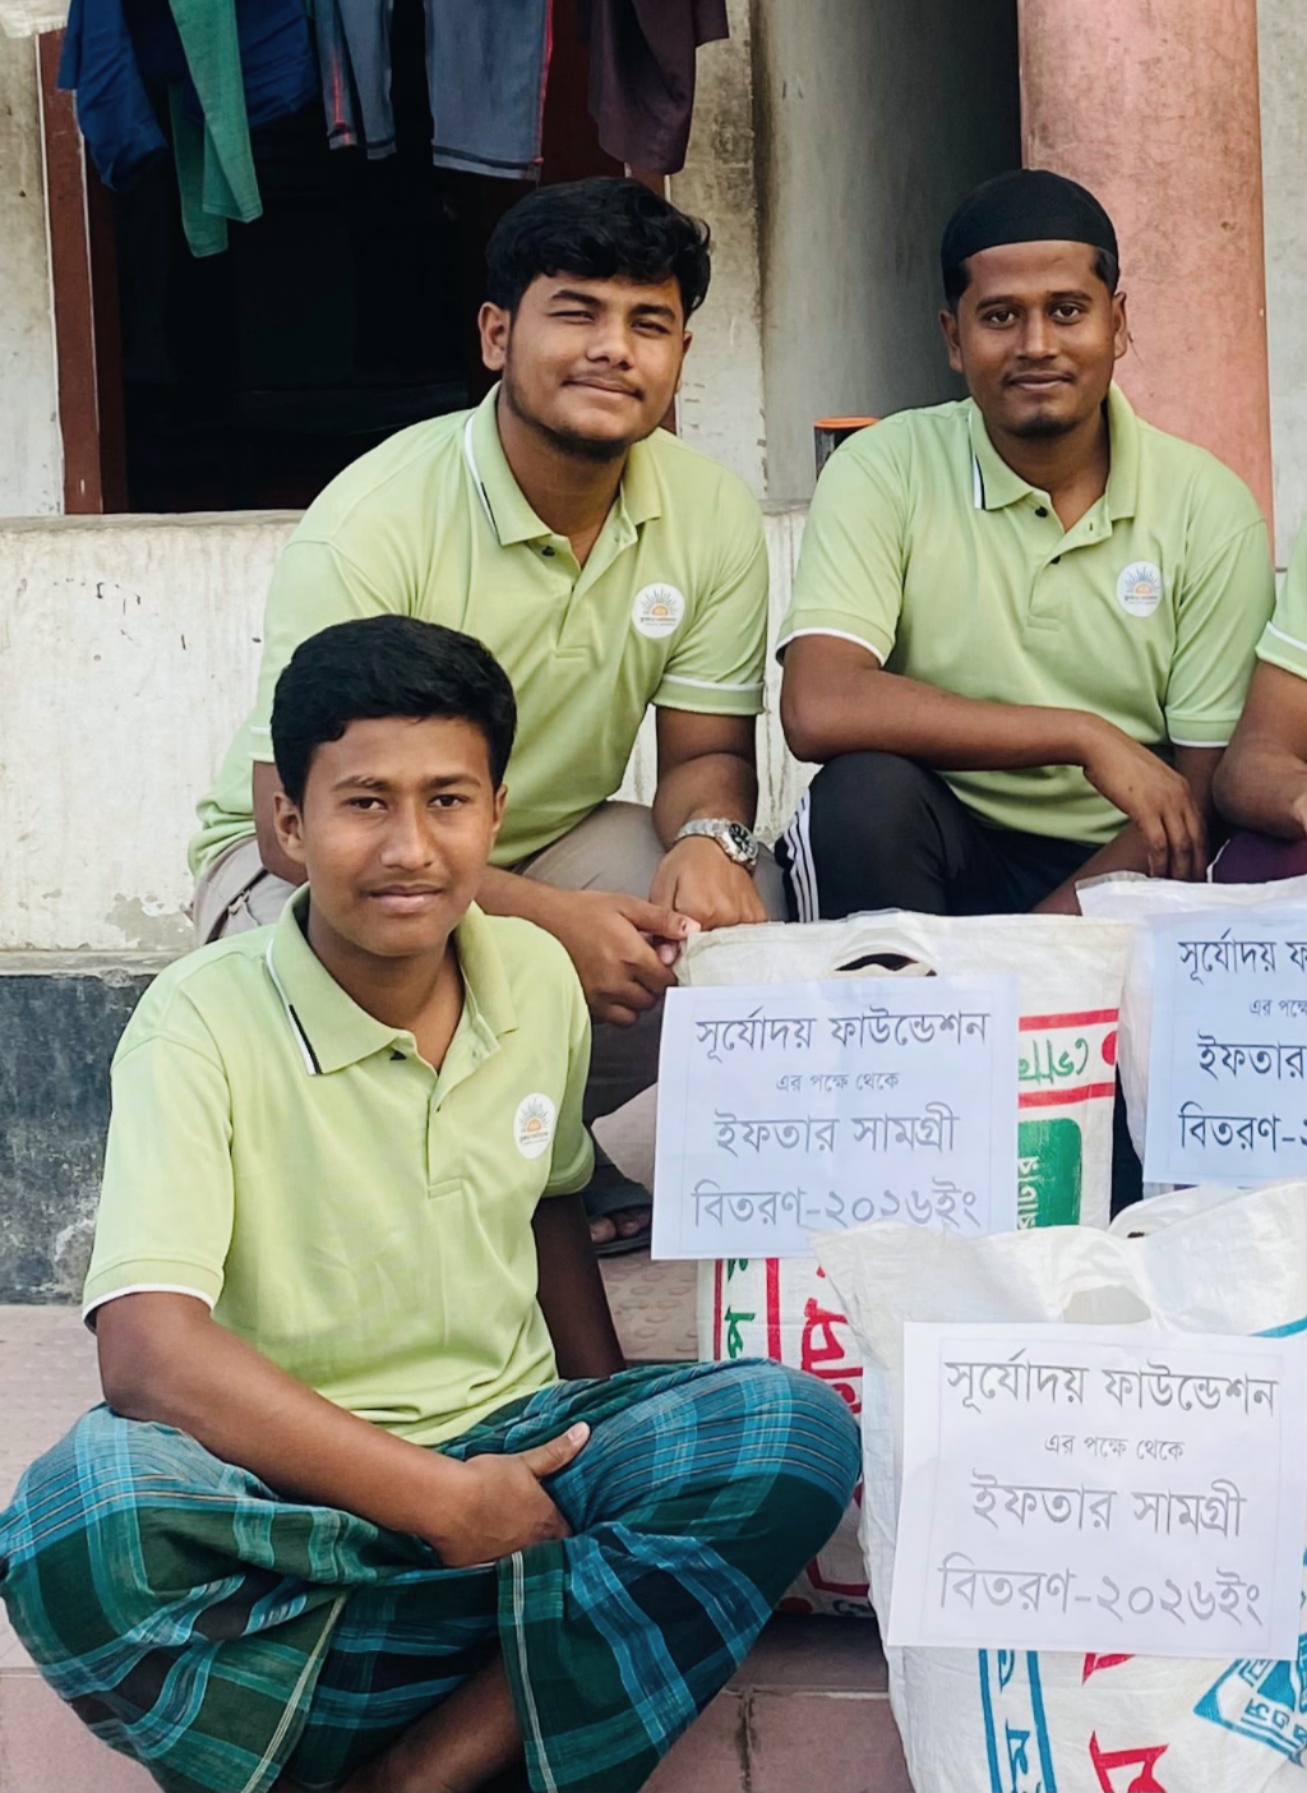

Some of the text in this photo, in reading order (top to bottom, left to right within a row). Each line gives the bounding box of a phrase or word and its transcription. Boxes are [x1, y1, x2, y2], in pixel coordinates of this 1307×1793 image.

[1178, 928, 1277, 984] সূর্যোদয়
[696, 1005, 990, 1062] সূর্যোদয় ফাউন্ডেশন
[1249, 999, 1273, 1016] এর
[776, 1072, 899, 1092] এর পক্ষে থেকে
[1197, 1032, 1307, 1080] ইফতার
[715, 1102, 960, 1156] ইফতার সামগ্রী
[944, 1348, 1279, 1414] সূর্যোদয় ফাউন্ডেশন
[1044, 1434, 1183, 1461] এর পক্ষে থেকে
[971, 1472, 1246, 1536] ইফতার সামগ্রী
[938, 1552, 1261, 1625] বিতরণ-২০২৬ইং
